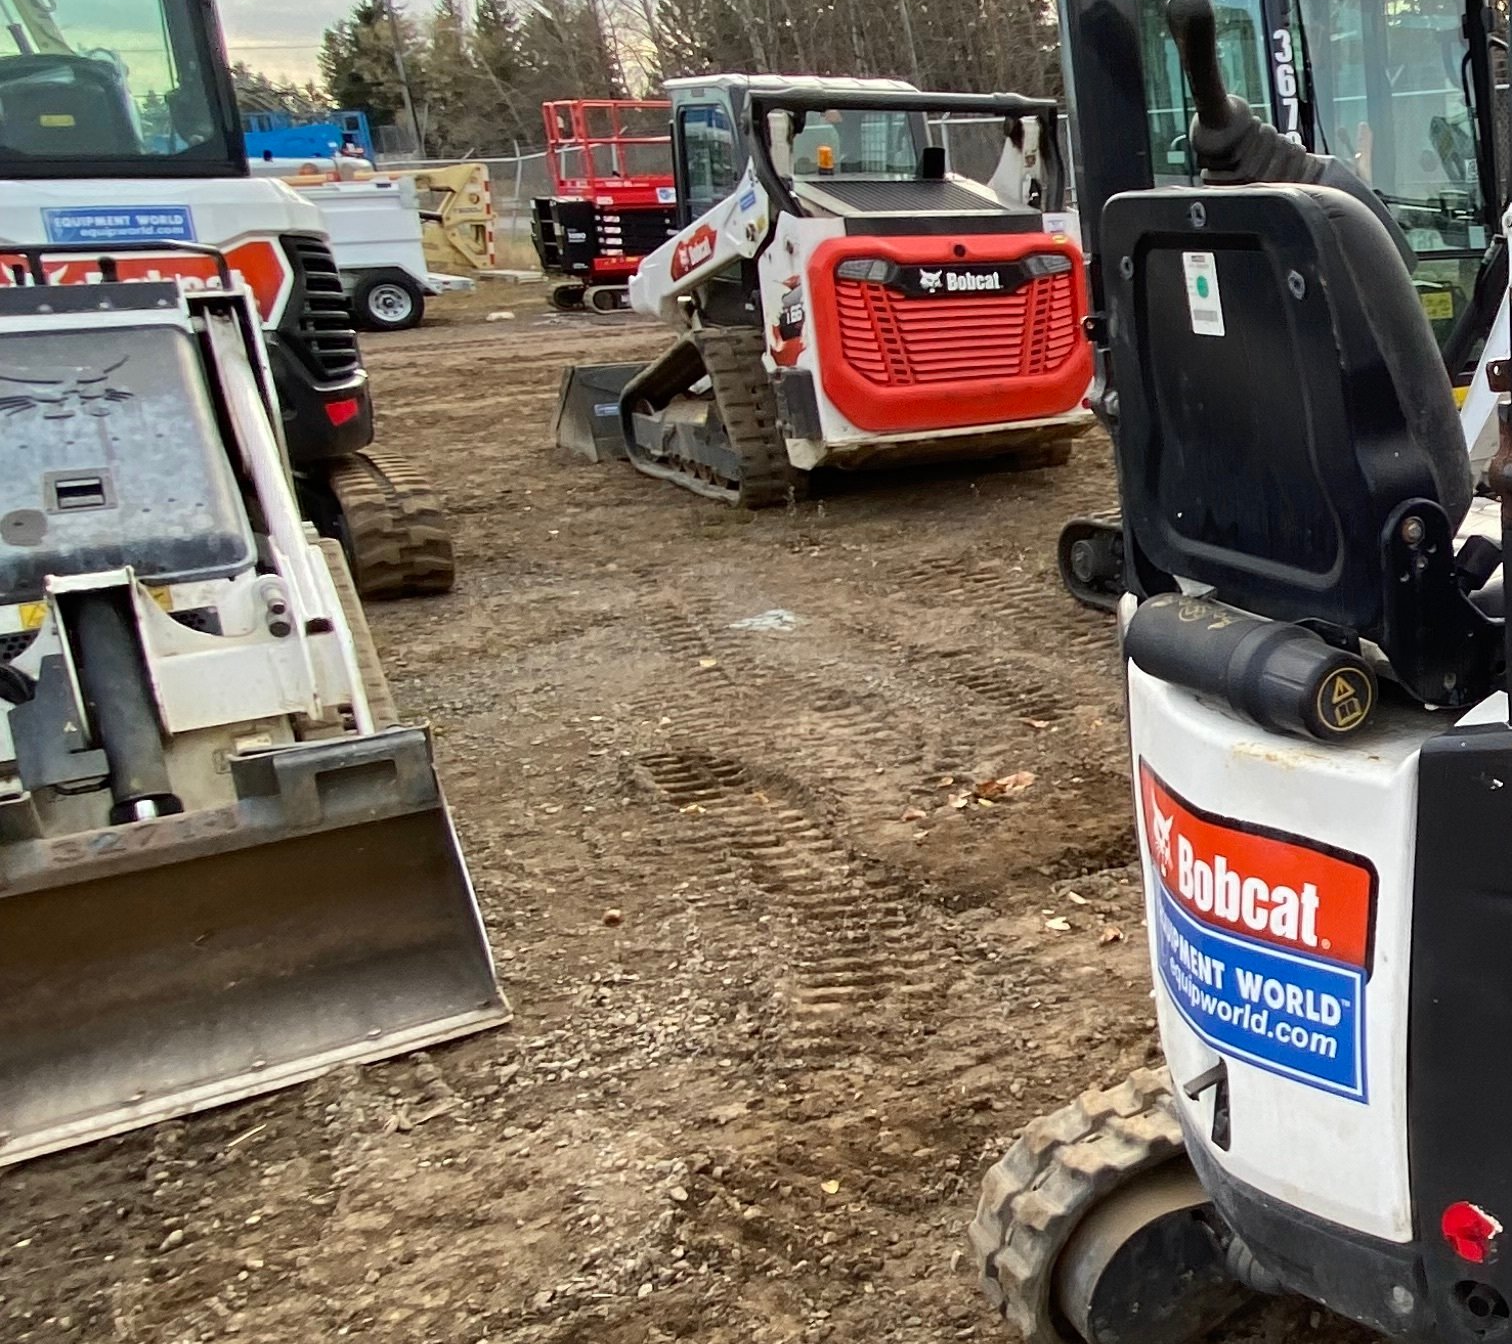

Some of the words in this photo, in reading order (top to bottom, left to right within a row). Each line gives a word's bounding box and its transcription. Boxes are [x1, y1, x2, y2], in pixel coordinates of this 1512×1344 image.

[54, 214, 130, 228] EQUIPMENT
[135, 214, 184, 226] WORLD
[946, 272, 1001, 291] Bobcat
[1177, 833, 1320, 948] Bobcat
[1169, 956, 1338, 1059] equipworld.com
